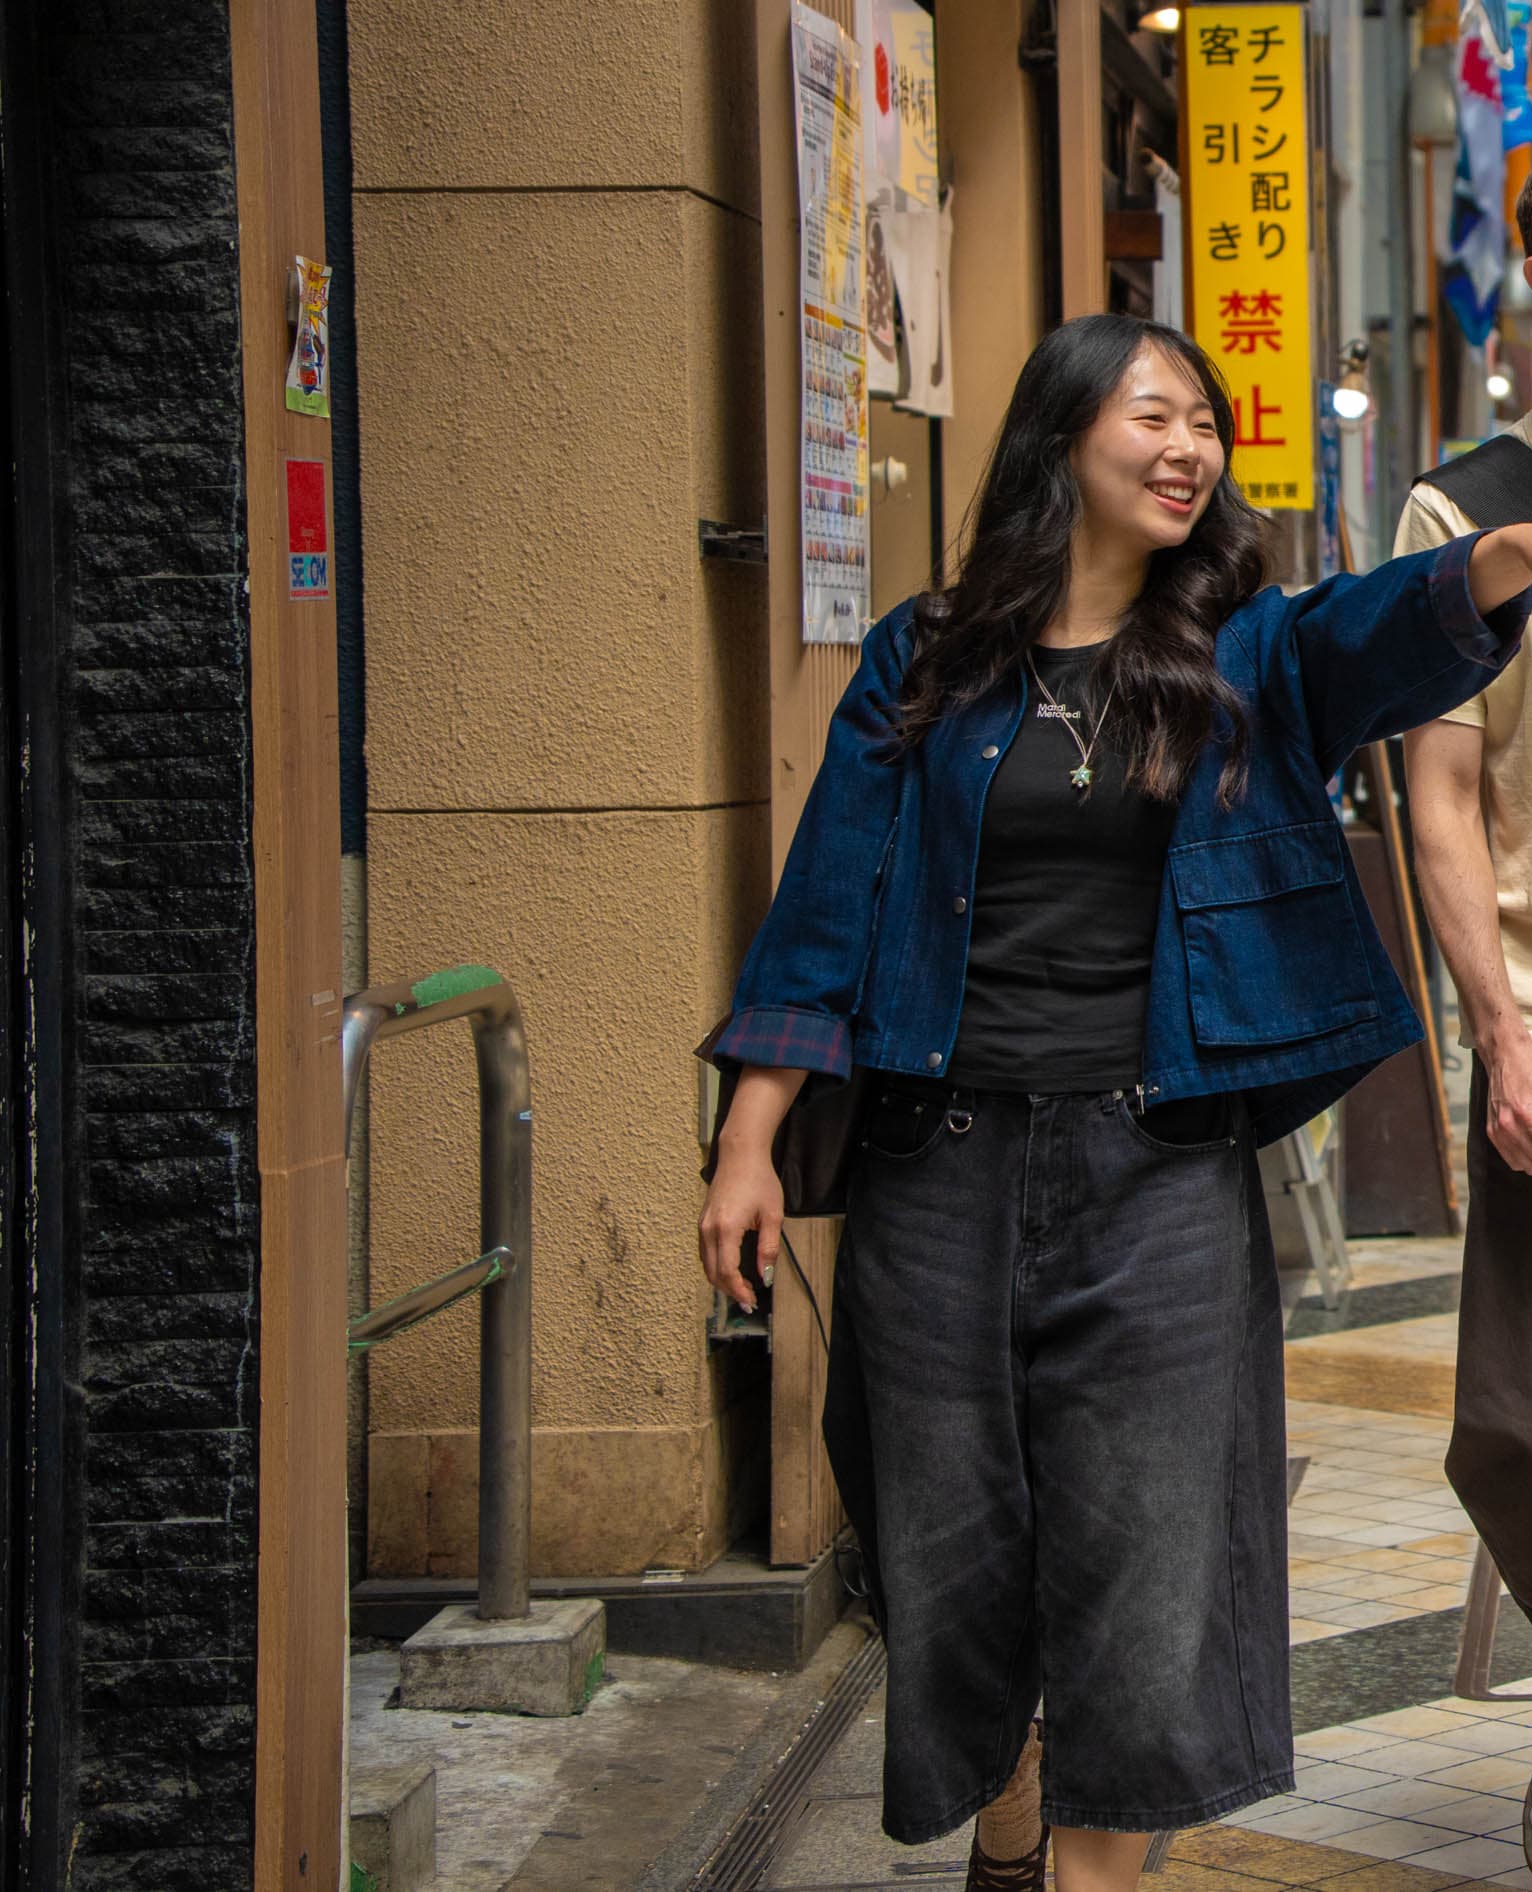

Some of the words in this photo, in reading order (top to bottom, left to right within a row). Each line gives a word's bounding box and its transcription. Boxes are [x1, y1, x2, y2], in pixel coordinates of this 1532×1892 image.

[1200, 24, 1243, 261] 客引き
[1247, 25, 1290, 261] チラシ配り
[1219, 288, 1286, 447] 禁止
[291, 556, 327, 587] SECOM
